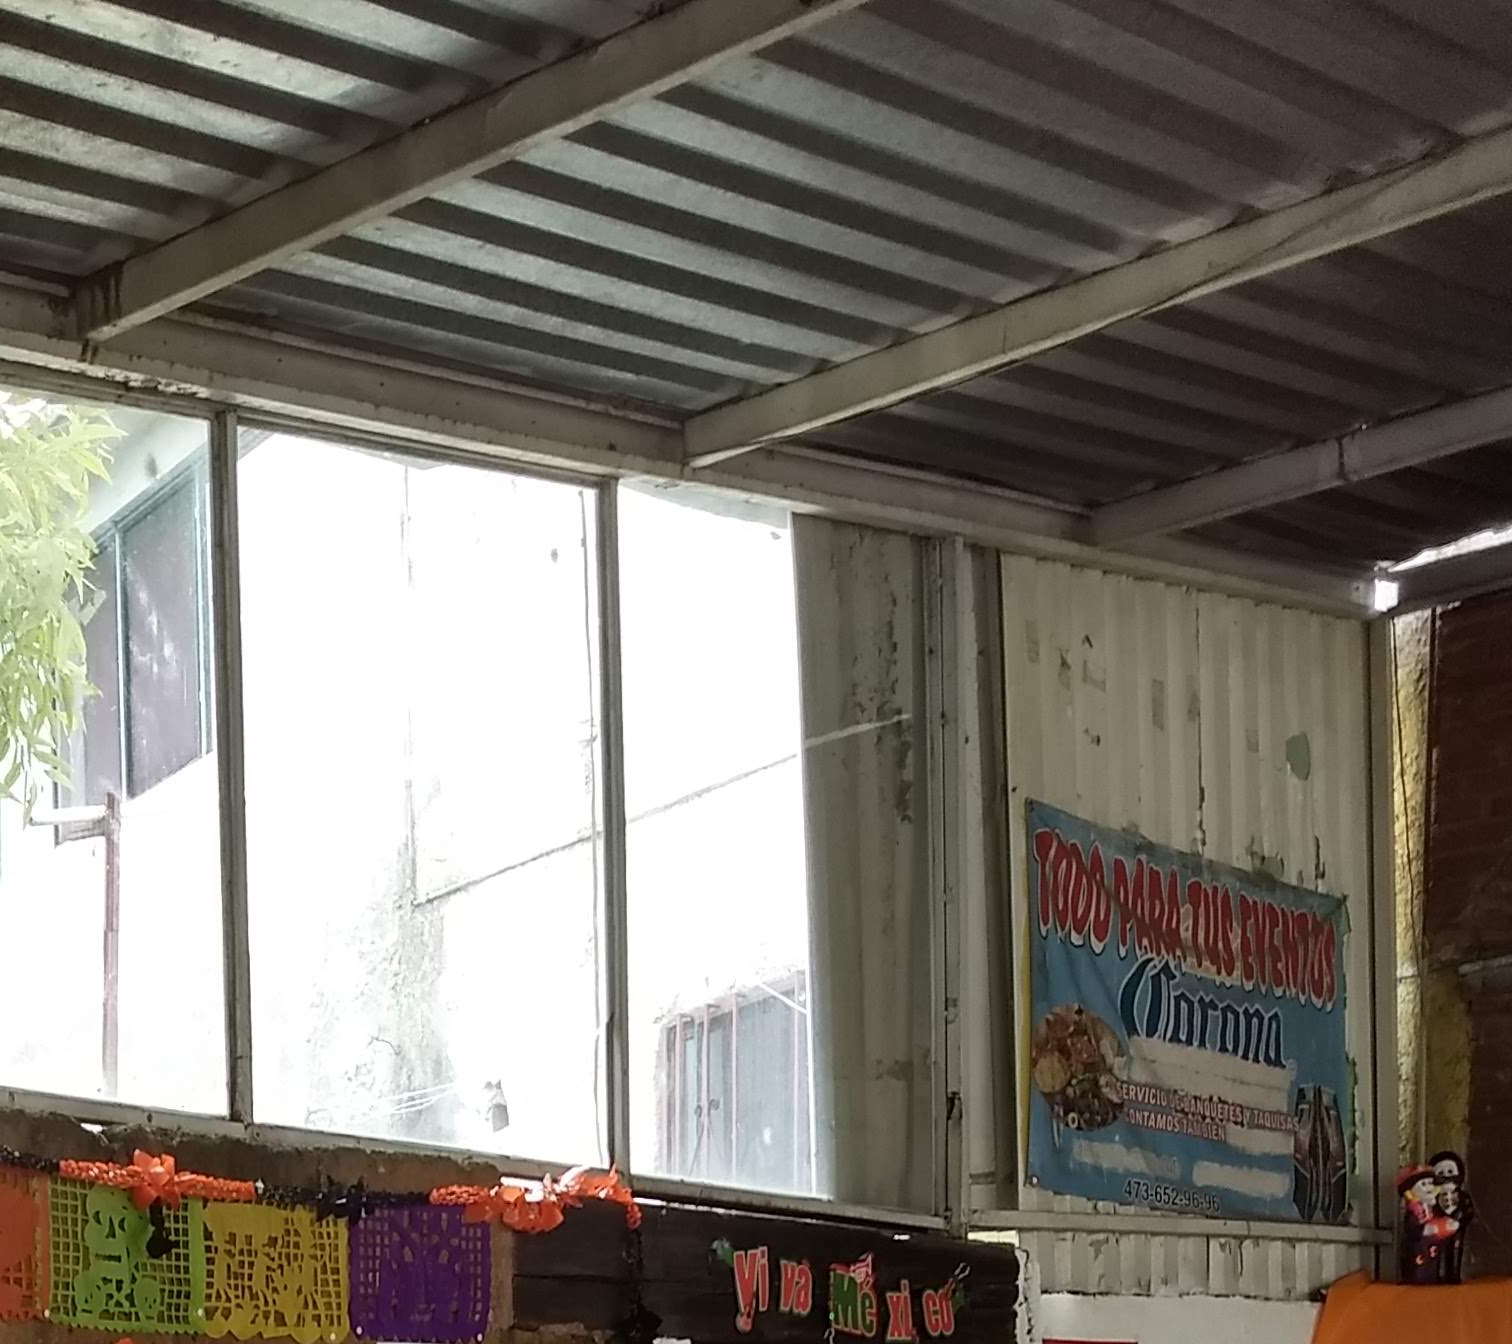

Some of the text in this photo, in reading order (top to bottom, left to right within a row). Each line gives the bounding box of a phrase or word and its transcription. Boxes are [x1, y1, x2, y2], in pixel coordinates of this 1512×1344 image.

[1033, 829, 1337, 1014] TODO PARA TUS EVENTOS
[1118, 955, 1288, 1069] Corona
[1116, 1082, 1168, 1106] SERVICIO
[1253, 1110, 1300, 1132] TAQUISAS
